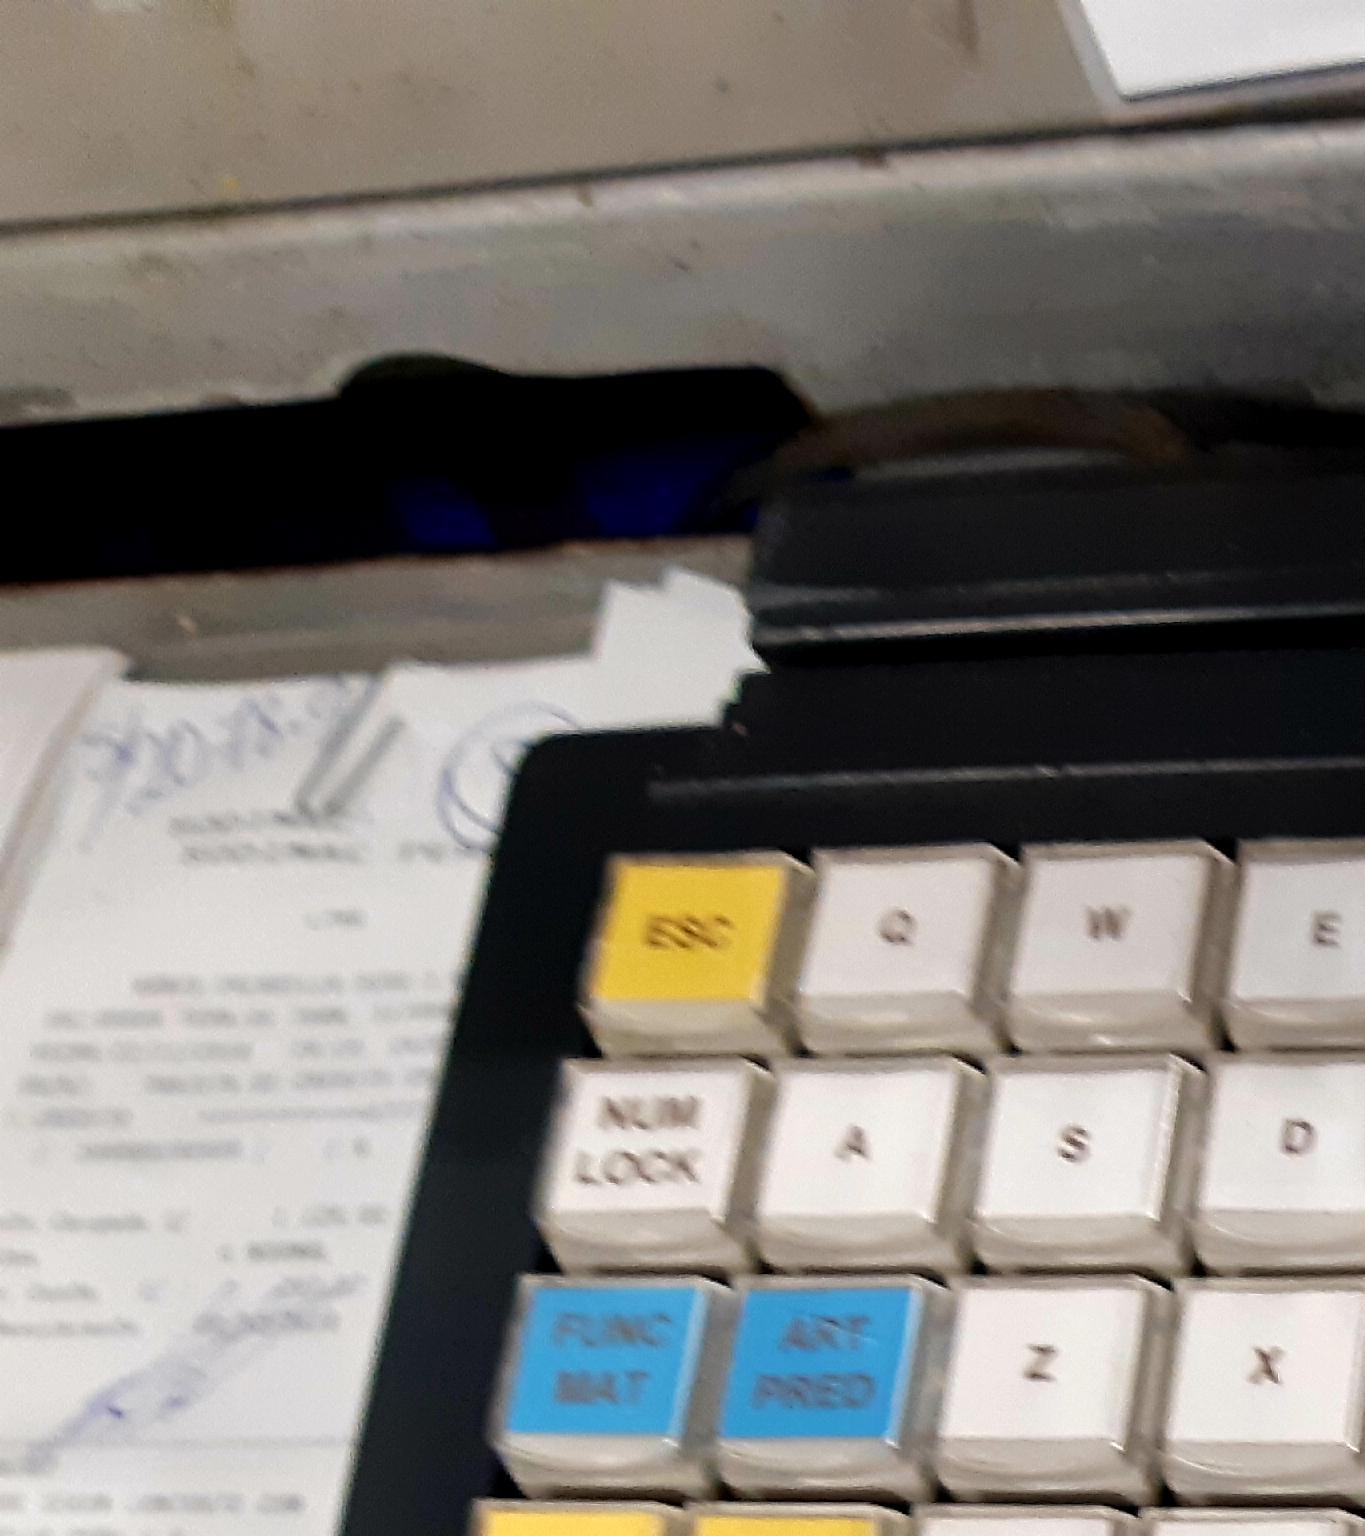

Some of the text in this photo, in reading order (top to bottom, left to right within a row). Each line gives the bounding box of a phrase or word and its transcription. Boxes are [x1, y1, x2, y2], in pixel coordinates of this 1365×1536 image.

[643, 915, 732, 951] ESC
[1088, 908, 1128, 940] W
[1311, 912, 1339, 947] E
[600, 1096, 700, 1131] NUM
[837, 1126, 868, 1160] A
[1058, 1126, 1088, 1162] S
[1281, 1119, 1315, 1155] D
[575, 1150, 698, 1186] LOCK
[554, 1312, 672, 1348] FUNC
[779, 1315, 870, 1353] ART
[1024, 1345, 1056, 1382] Z
[1250, 1348, 1280, 1384] X
[554, 1370, 649, 1405] MAT
[753, 1372, 876, 1410] PRED
